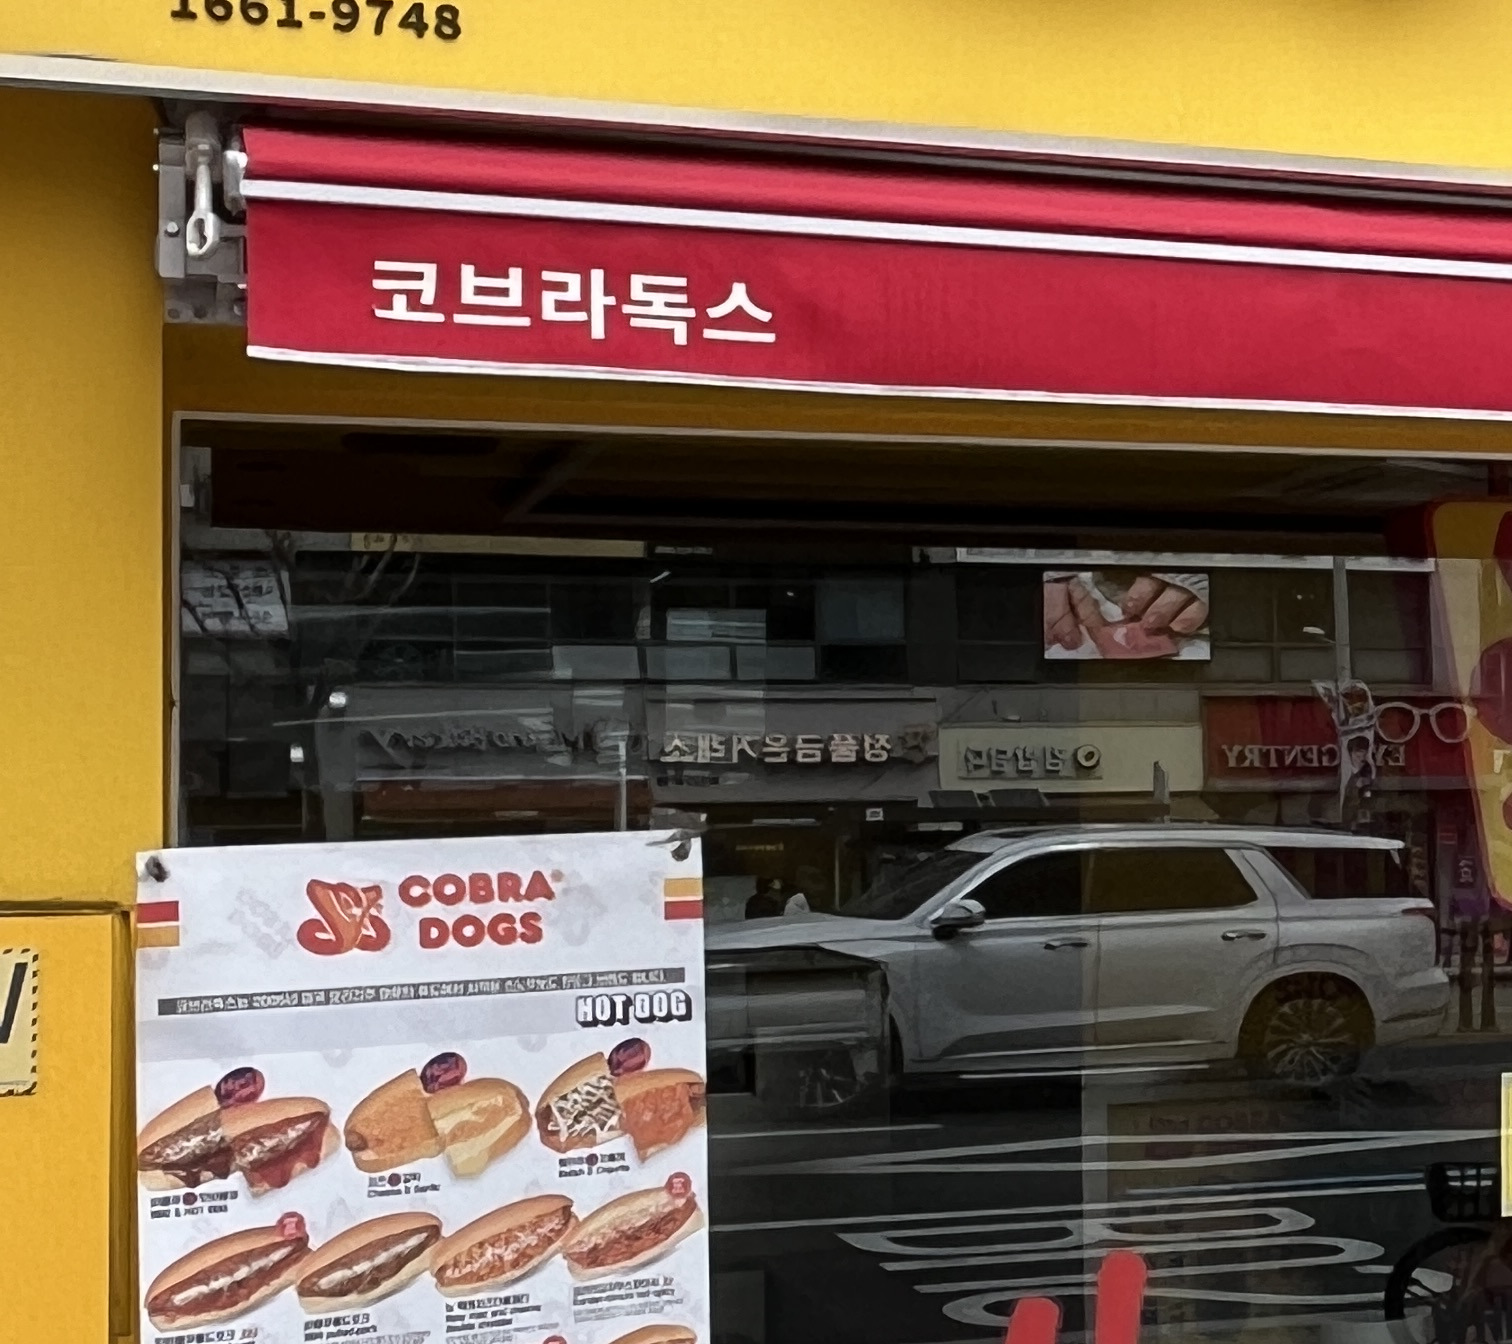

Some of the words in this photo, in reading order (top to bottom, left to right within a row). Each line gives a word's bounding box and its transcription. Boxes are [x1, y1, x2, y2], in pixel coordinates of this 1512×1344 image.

[371, 260, 777, 346] 코브라독스
[399, 870, 555, 908] COBRA
[418, 911, 543, 949] DOGS
[576, 992, 629, 1027] HOT
[633, 989, 692, 1023] DOG
